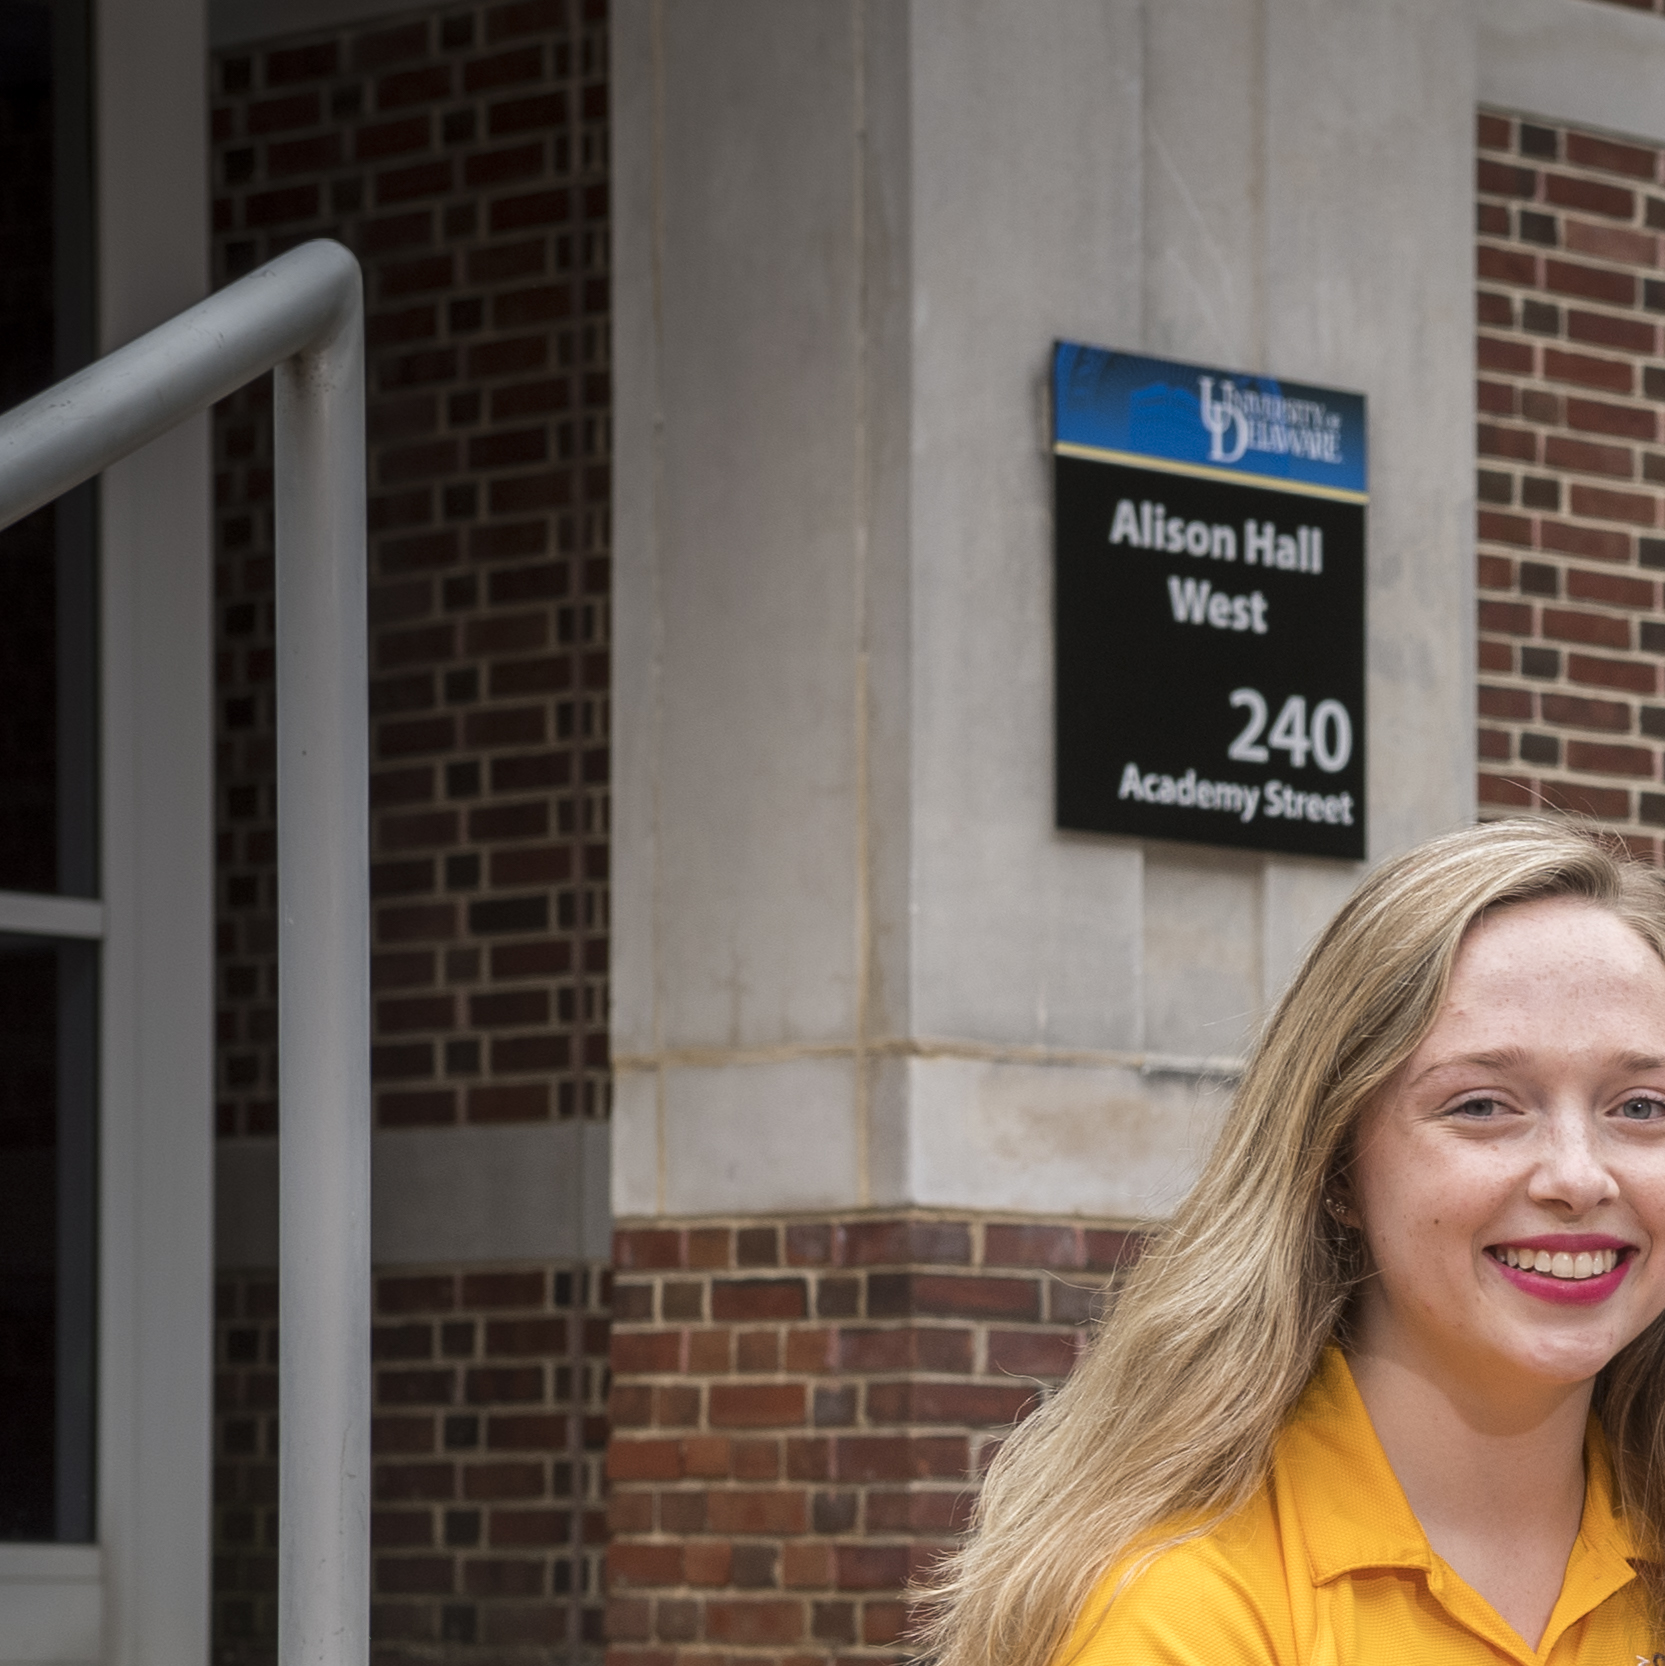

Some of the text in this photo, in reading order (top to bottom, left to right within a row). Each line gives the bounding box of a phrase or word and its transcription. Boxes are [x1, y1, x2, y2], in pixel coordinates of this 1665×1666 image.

[1110, 499, 1323, 574] Alison Hall
[1168, 576, 1268, 633] West
[1228, 687, 1352, 773] 240
[1118, 763, 1354, 826] Academy Street
